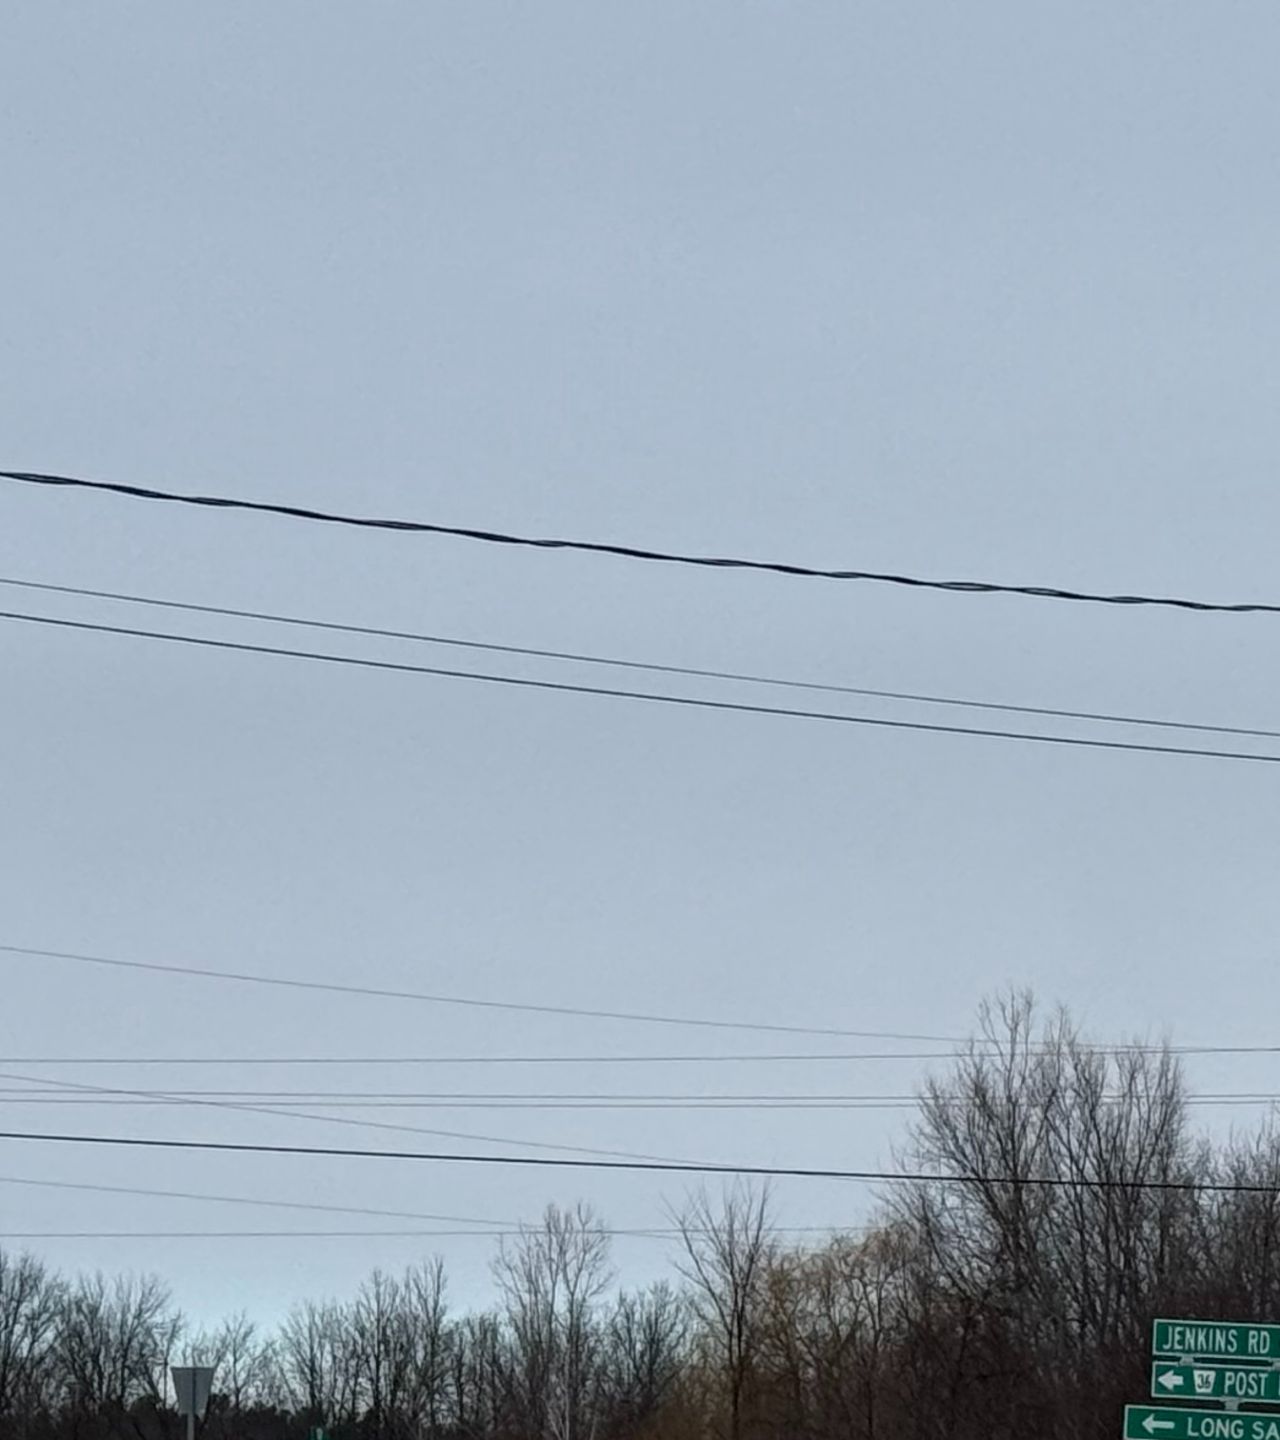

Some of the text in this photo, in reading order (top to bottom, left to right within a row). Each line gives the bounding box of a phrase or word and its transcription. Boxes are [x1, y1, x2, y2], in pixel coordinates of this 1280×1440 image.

[1162, 1326, 1270, 1354] JENKINS RD
[1224, 1371, 1268, 1397] POST
[1187, 1417, 1244, 1439] LONG
